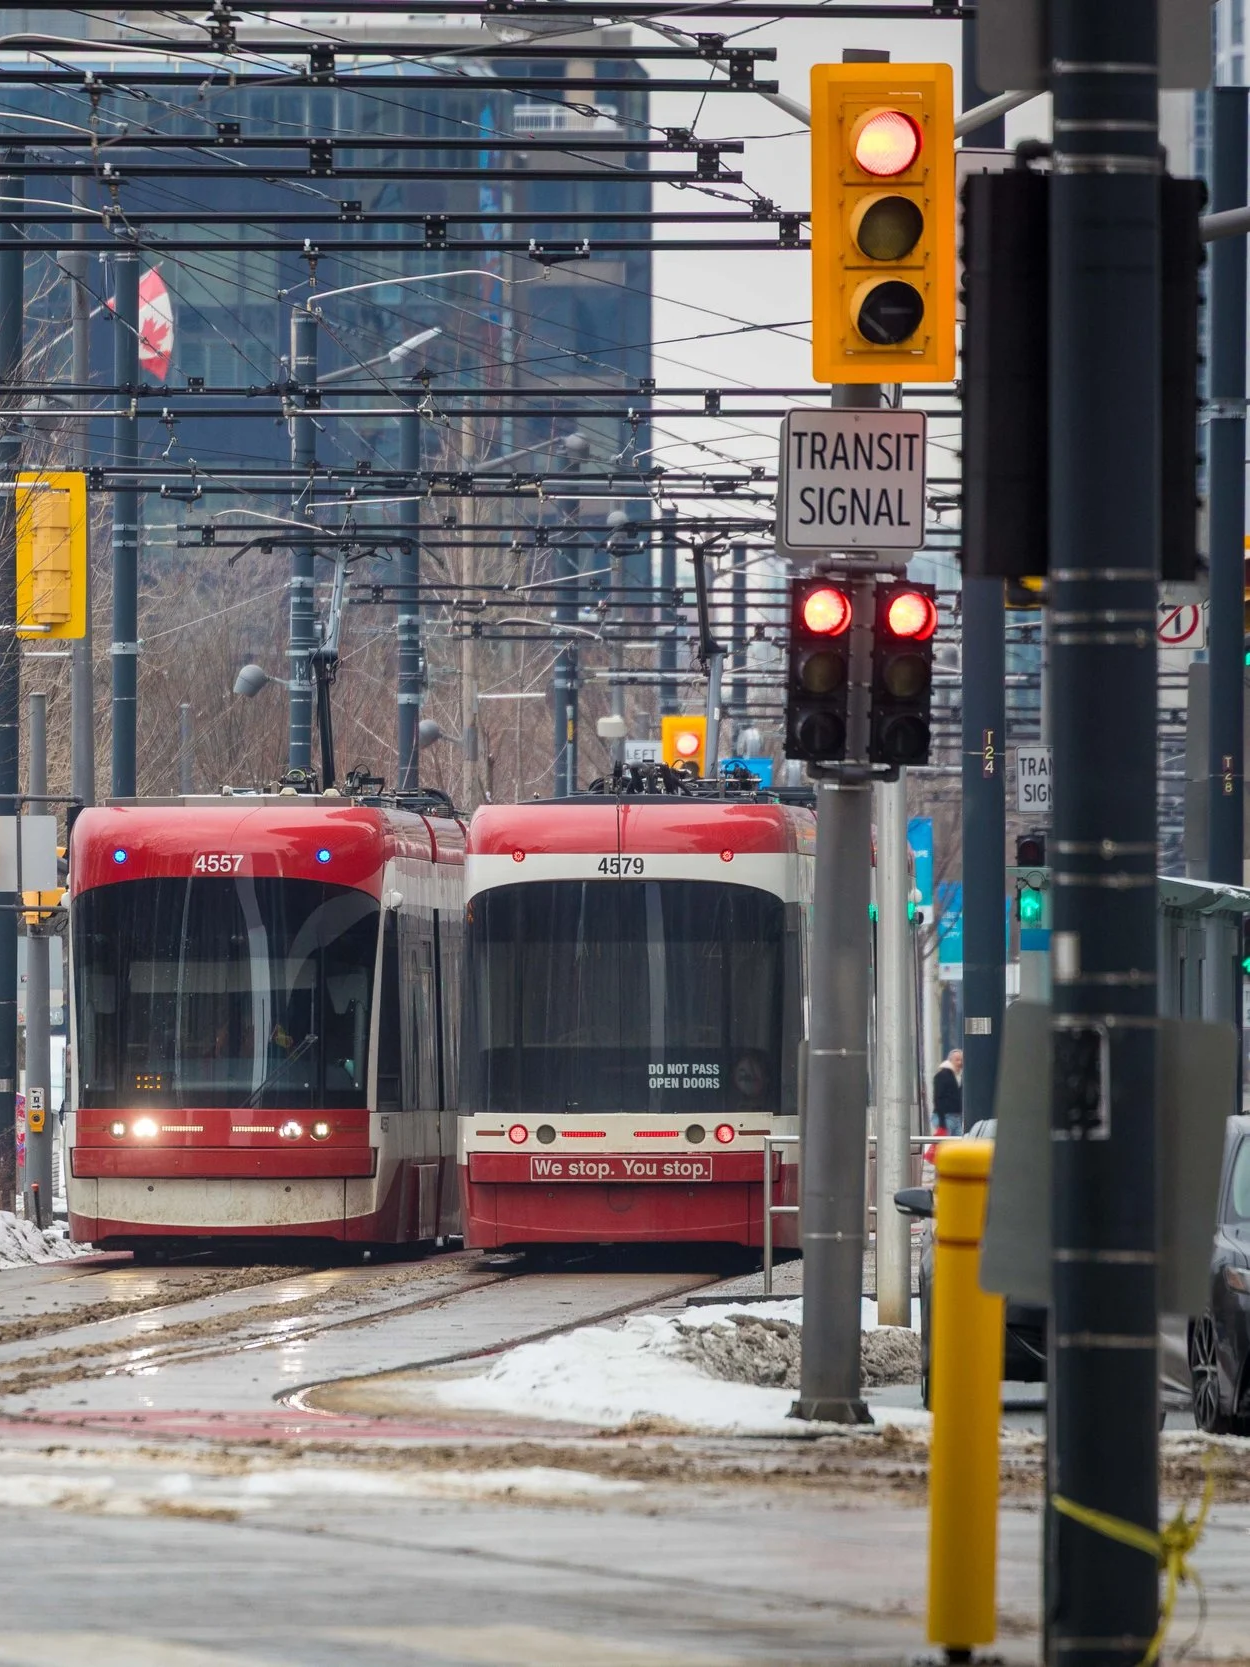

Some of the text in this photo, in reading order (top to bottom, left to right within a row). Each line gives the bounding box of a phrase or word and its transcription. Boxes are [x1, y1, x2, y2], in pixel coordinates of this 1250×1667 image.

[792, 431, 920, 471] TRANSIT
[798, 487, 911, 526] SIGNAL
[626, 749, 657, 760] LEFT
[194, 854, 244, 872] 4557
[597, 857, 644, 875] 4579
[648, 1063, 720, 1075] DO NOT PASS
[649, 1077, 720, 1089] OPEN DOORS
[534, 1160, 709, 1179] We stop. You stop.
